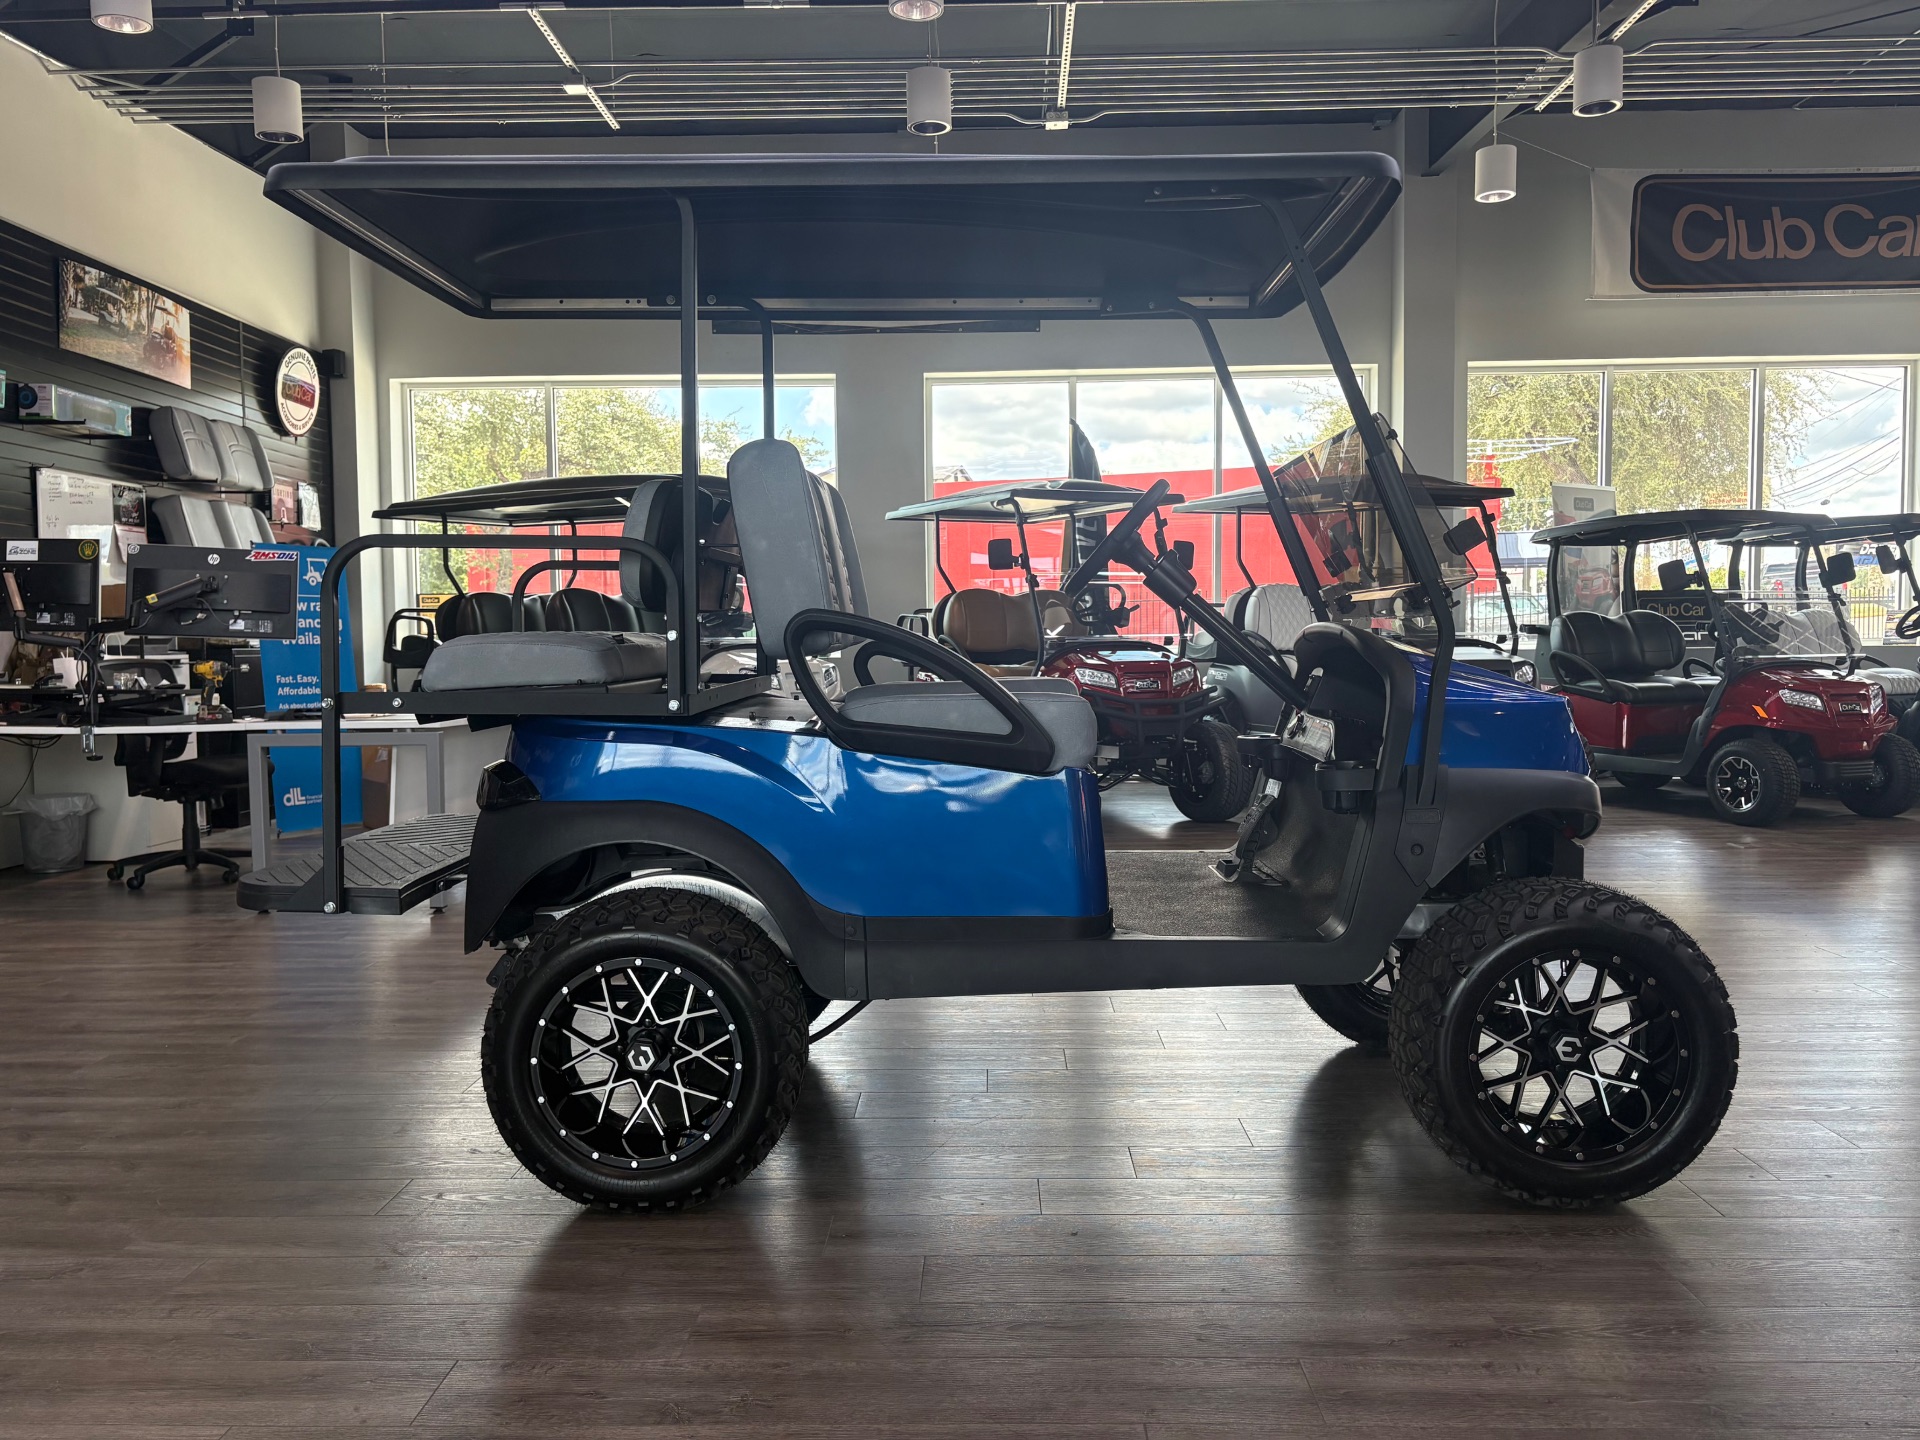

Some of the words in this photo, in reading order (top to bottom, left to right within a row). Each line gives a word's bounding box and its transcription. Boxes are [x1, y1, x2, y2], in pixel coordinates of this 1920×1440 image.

[1671, 203, 1816, 262] Club
[251, 551, 297, 560] AMSOIL
[1646, 603, 1679, 617] Club
[1680, 602, 1706, 617] Car
[276, 675, 296, 684] Fast.
[297, 675, 319, 685] Easy.
